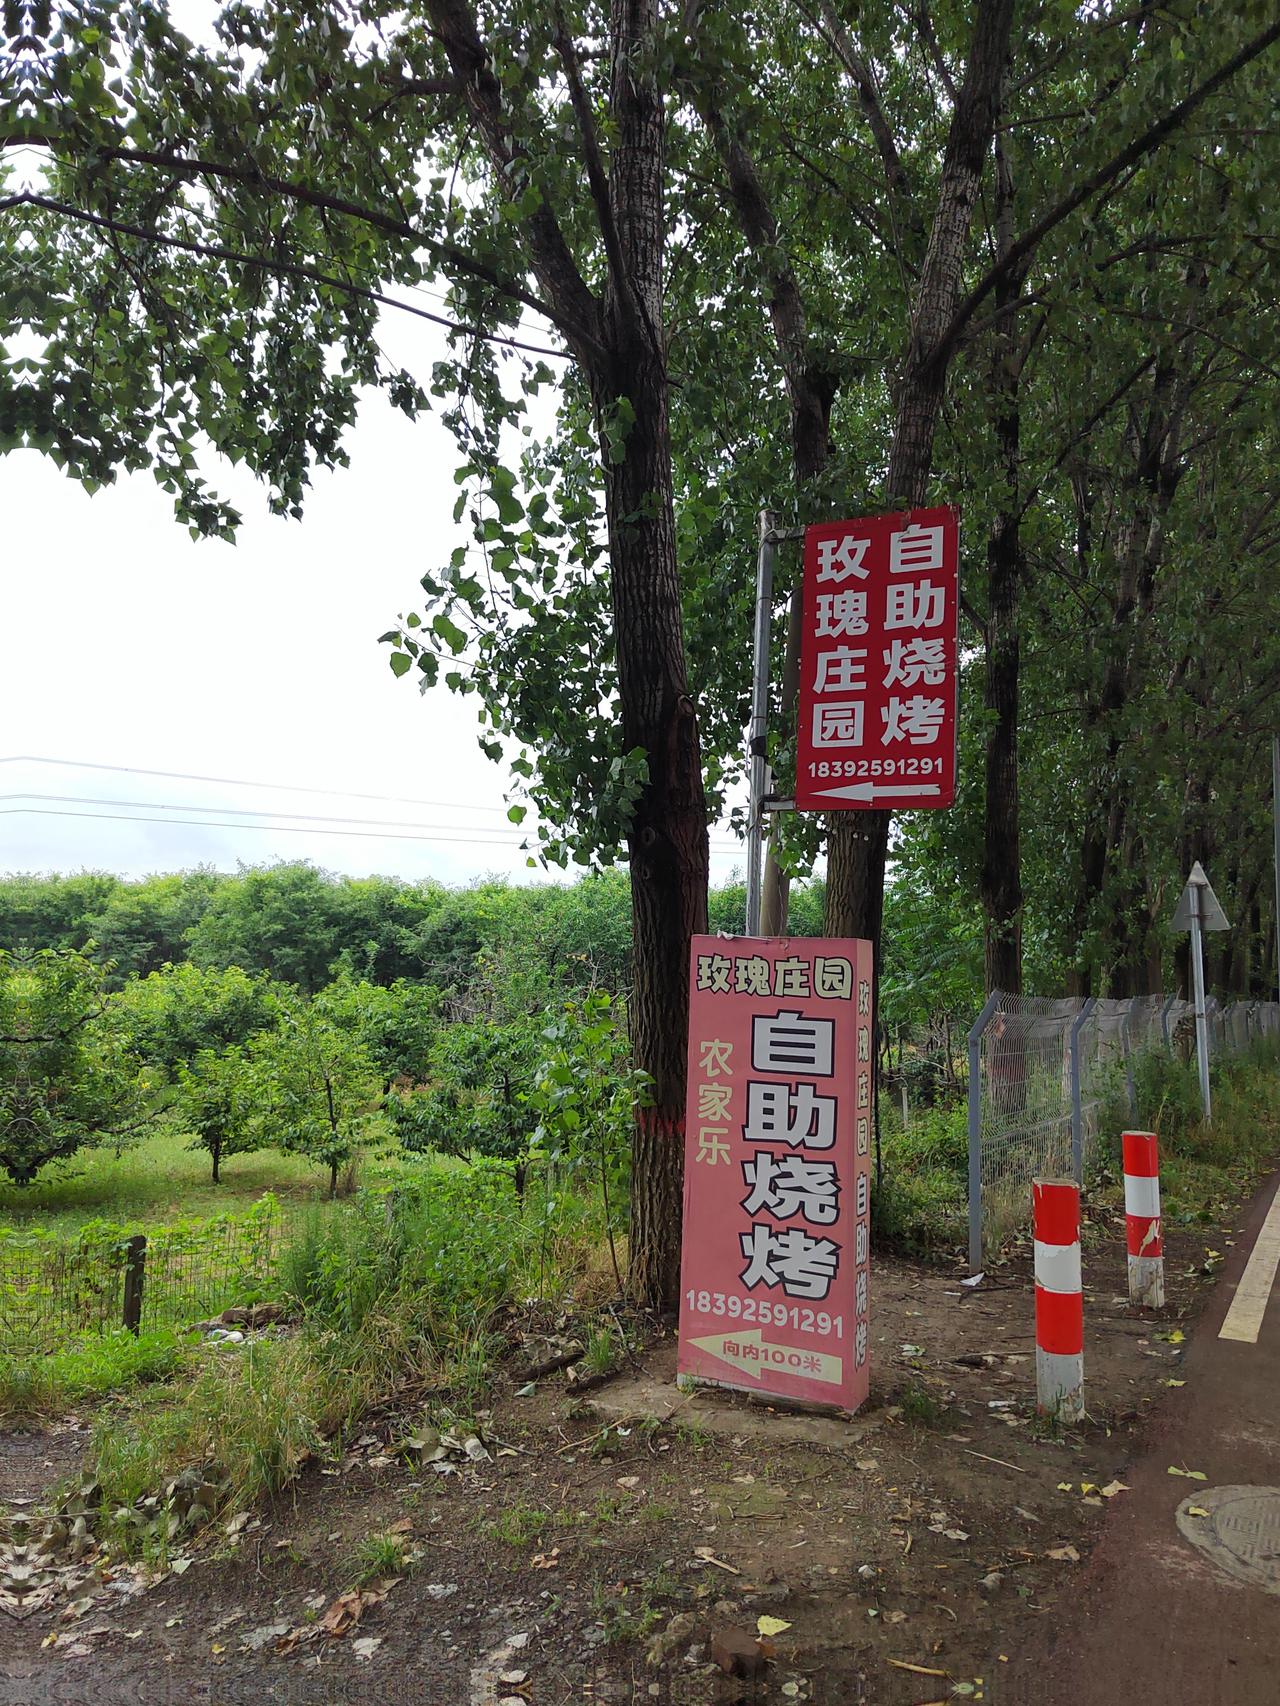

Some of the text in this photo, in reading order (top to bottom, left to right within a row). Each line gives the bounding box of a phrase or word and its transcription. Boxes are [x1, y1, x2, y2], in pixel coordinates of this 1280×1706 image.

[811, 535, 871, 748] 玫瑰庄园
[880, 524, 946, 748] 自助烧烤
[808, 757, 943, 778] 18392591291
[696, 953, 853, 1001] 玫瑰庄园
[695, 1038, 734, 1166] 农家乐
[740, 1009, 843, 1301] 自助烧烤
[855, 980, 870, 1374] 玫瑰庄园 自助烧烤
[686, 1289, 844, 1339] 18392591291
[722, 1340, 822, 1373] 向内100米
